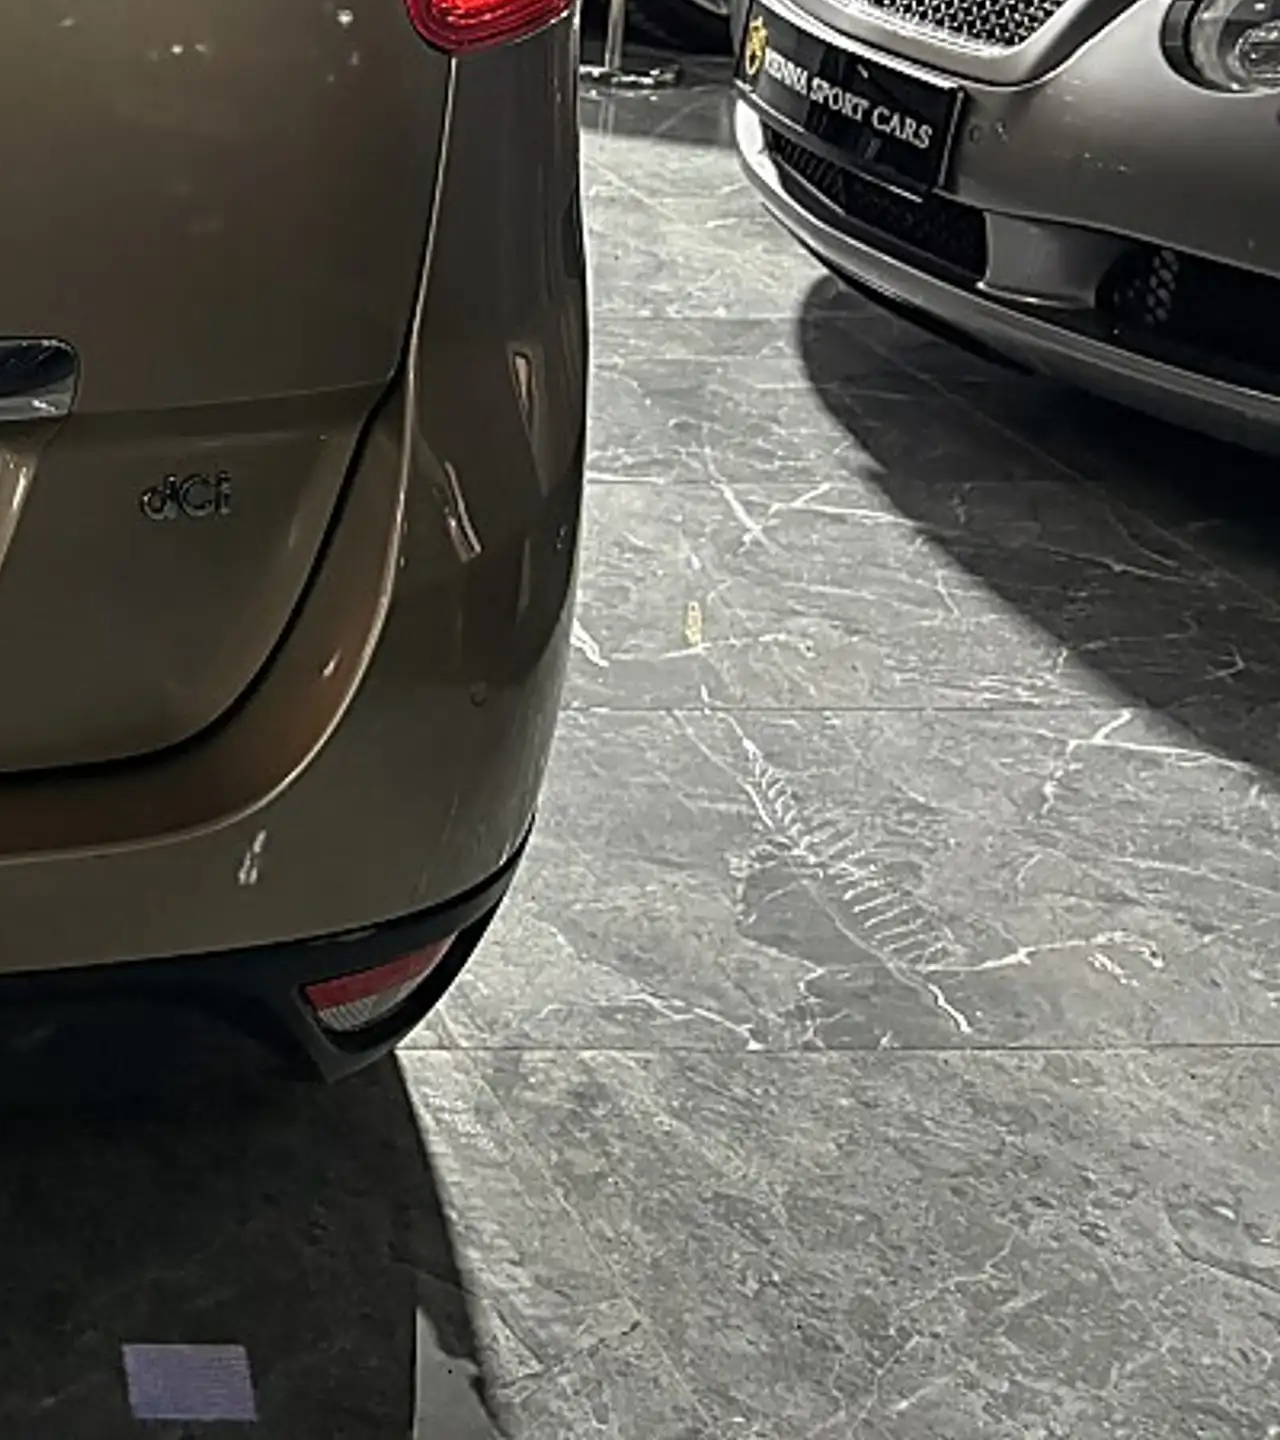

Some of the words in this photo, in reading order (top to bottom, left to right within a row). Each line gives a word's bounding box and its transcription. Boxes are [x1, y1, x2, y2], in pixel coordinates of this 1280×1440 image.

[809, 76, 870, 123] SPORT
[871, 106, 934, 150] CARS
[140, 470, 233, 521] dCi
